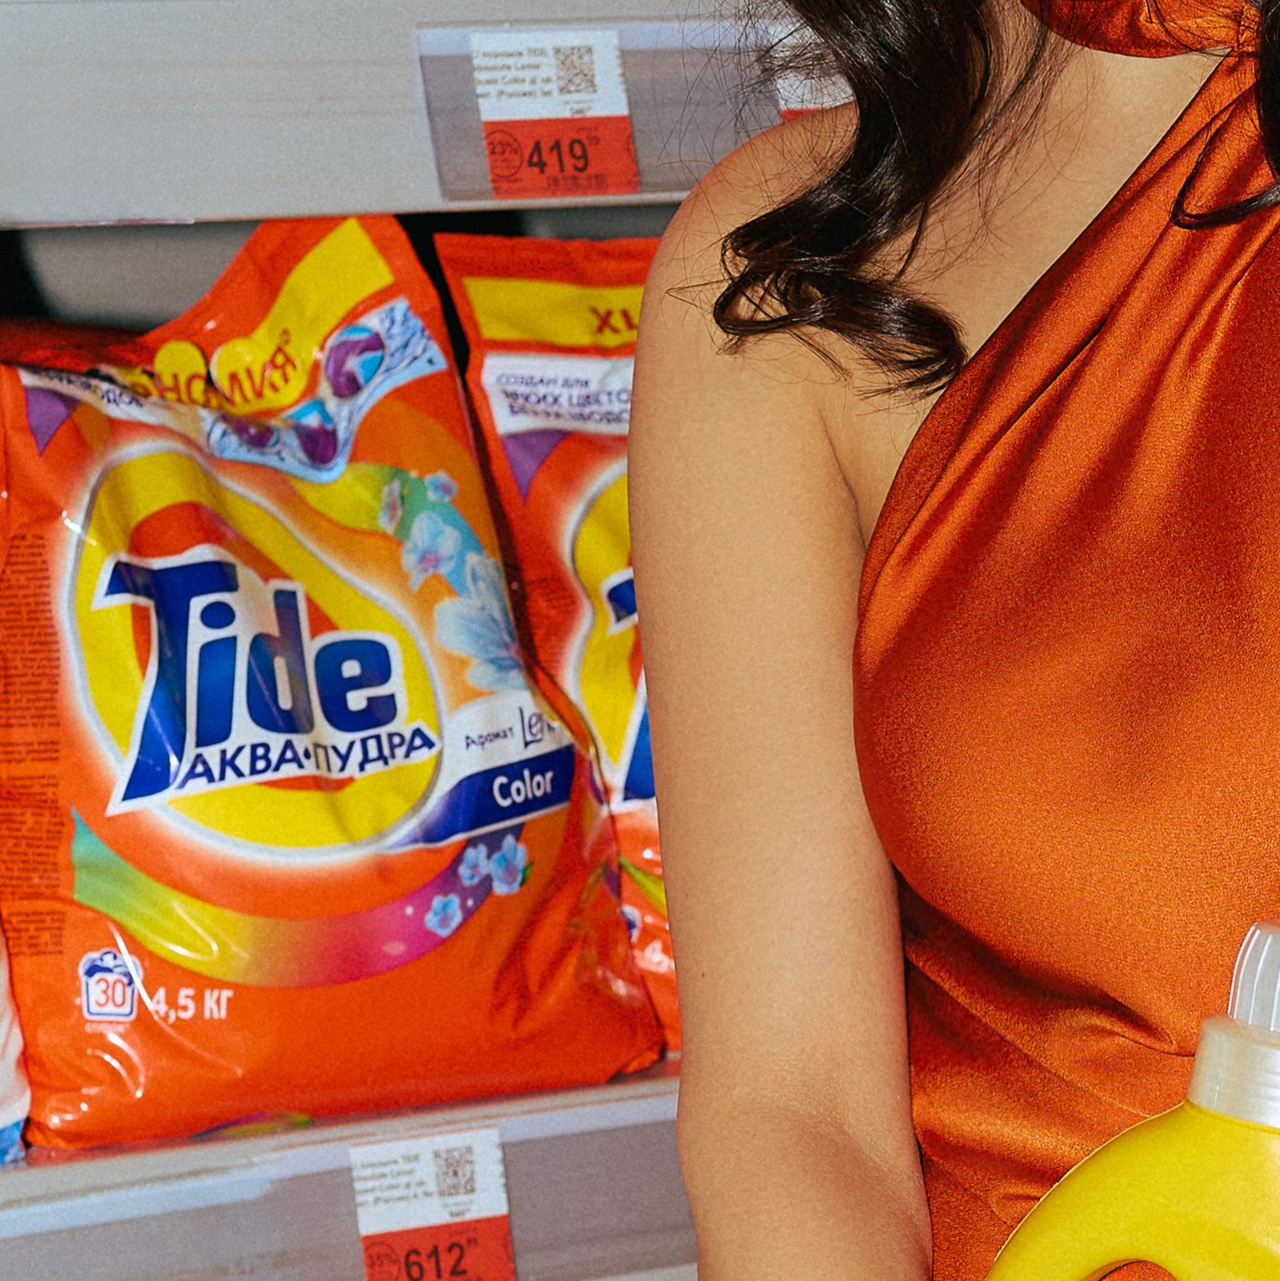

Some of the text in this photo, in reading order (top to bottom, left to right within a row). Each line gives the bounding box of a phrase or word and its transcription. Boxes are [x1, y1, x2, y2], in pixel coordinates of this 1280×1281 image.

[527, 138, 589, 174] 419
[105, 559, 398, 800] Tide
[492, 767, 554, 808] Color
[95, 978, 126, 1008] 30
[203, 988, 234, 1021] КГ
